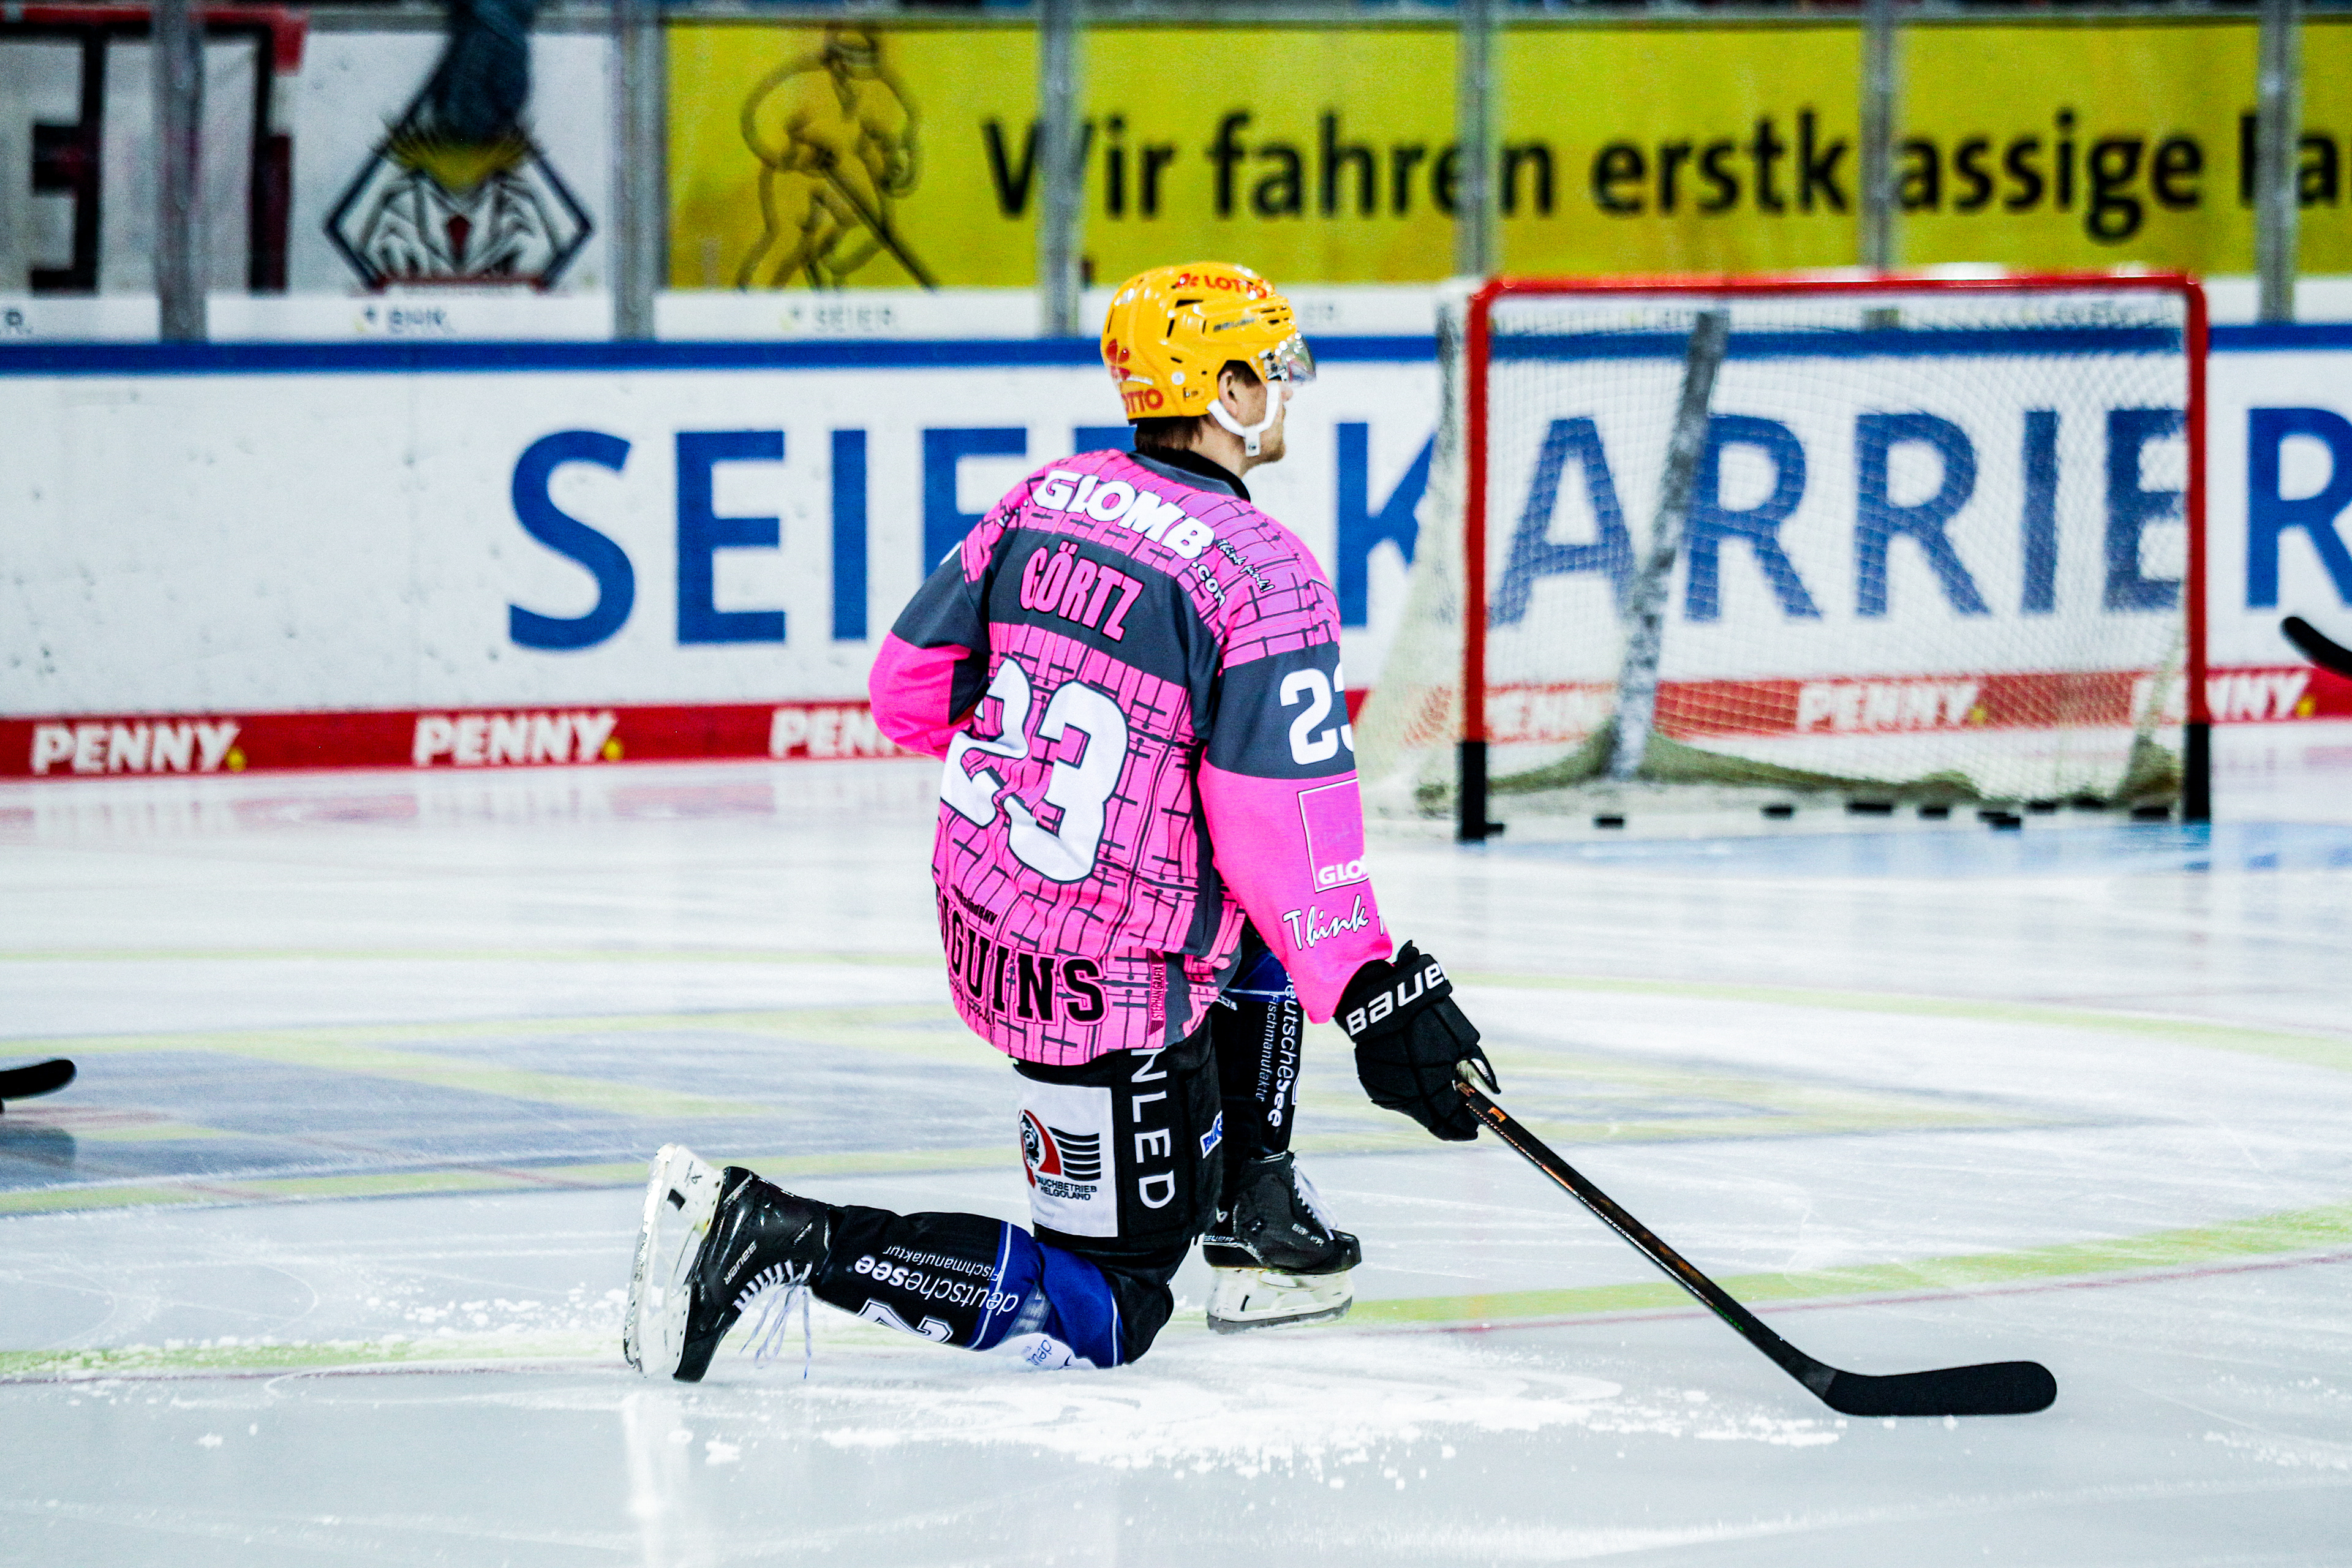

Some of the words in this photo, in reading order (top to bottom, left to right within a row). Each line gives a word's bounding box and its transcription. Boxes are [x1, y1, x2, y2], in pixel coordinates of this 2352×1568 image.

[1590, 104, 2203, 244] erstkassige
[508, 425, 1133, 652] SEIE
[1031, 469, 1216, 560] GLOMB
[1019, 541, 1145, 644] GÖRTZ
[1279, 667, 1355, 765] 2
[940, 657, 1129, 883] 23
[1283, 893, 1370, 951] Think
[854, 1255, 1020, 1316] deutschesee
[882, 1245, 1004, 1281] Fischmanufaktur
